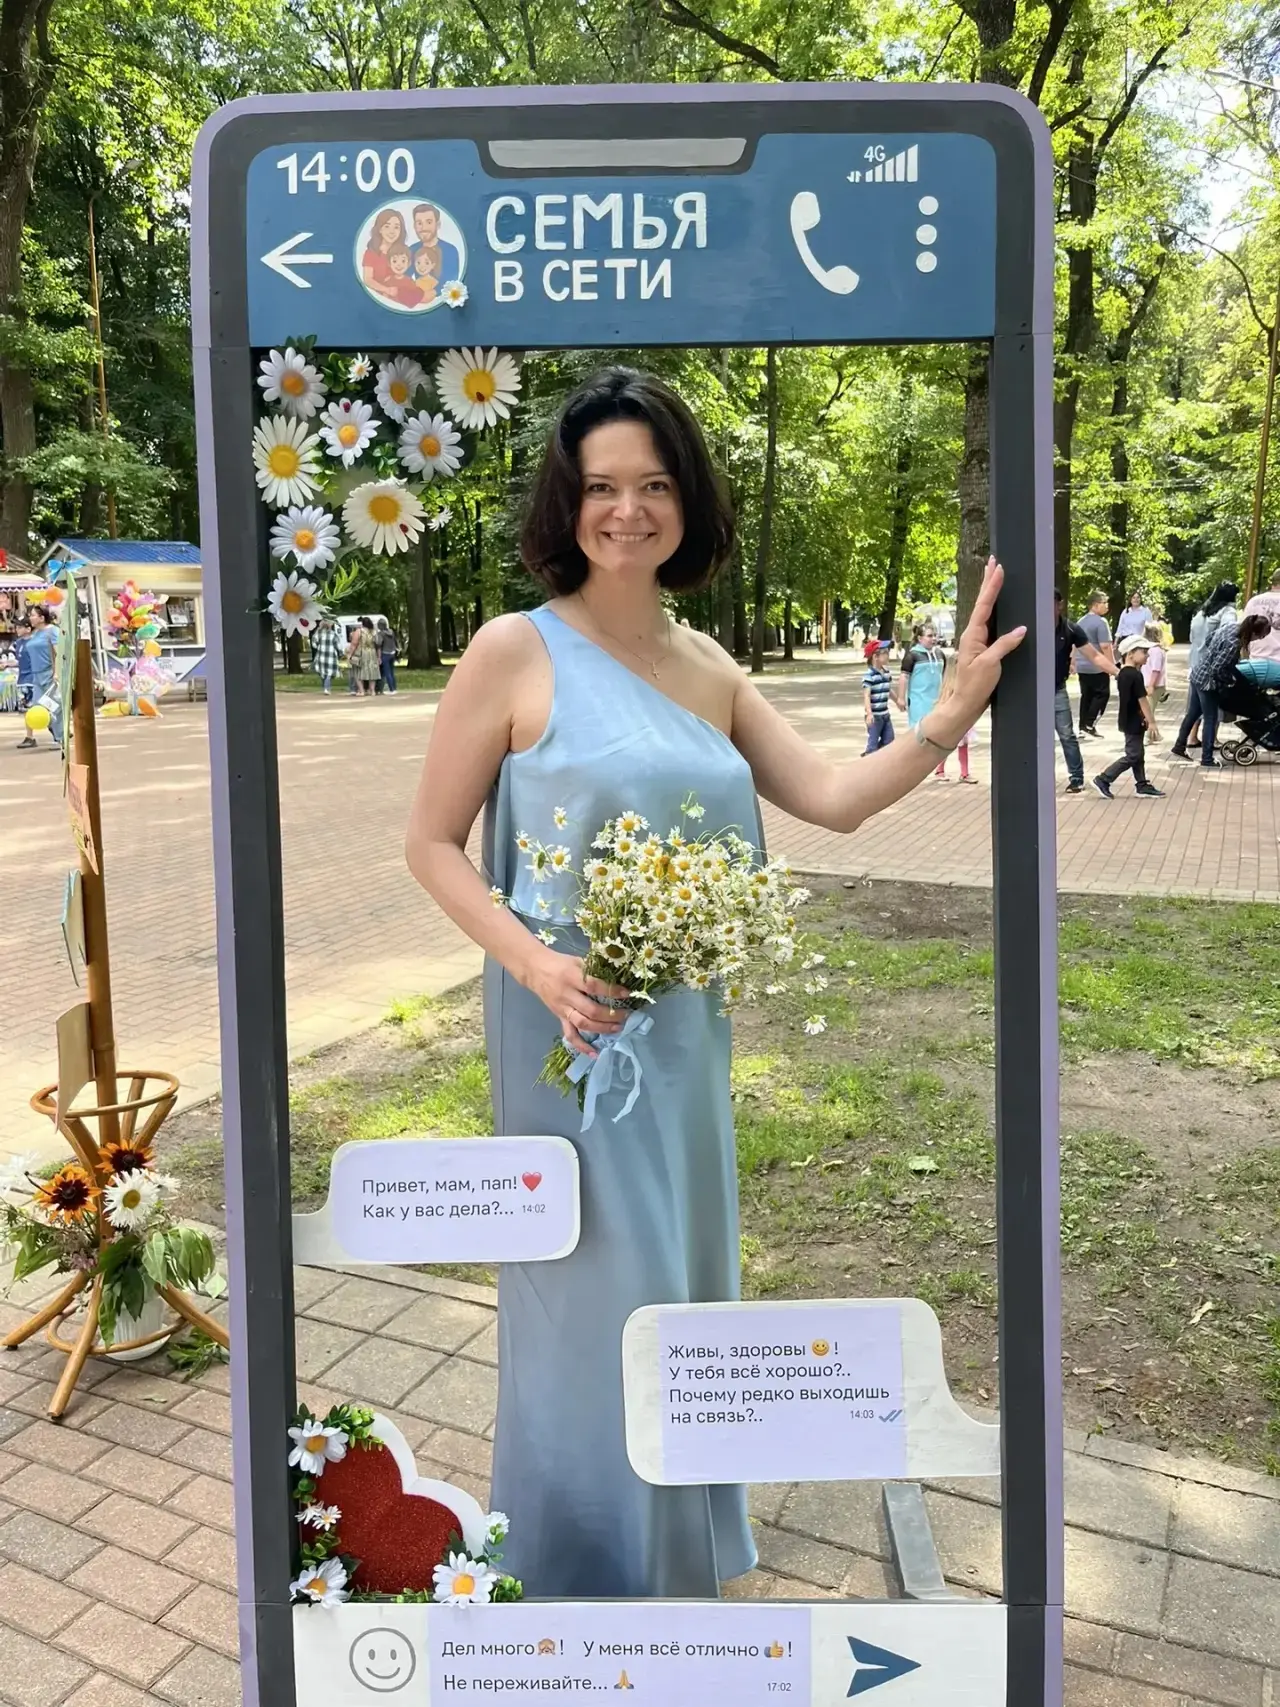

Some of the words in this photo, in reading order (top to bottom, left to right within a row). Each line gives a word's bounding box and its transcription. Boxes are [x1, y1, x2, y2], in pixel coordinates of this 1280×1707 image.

[863, 144, 886, 163] 4G
[276, 147, 416, 195] 14:00
[486, 191, 708, 254] СЕМЬЯ
[494, 260, 524, 302] В
[542, 258, 672, 302] СЕТИ
[362, 1179, 430, 1197] Привет,
[435, 1179, 476, 1194] мам,
[481, 1175, 518, 1191] пап!
[363, 1203, 396, 1219] Как
[399, 1206, 410, 1222] у
[415, 1205, 445, 1218] вас
[448, 1200, 514, 1219] дела?...
[522, 1203, 546, 1214] 14:02
[667, 1344, 725, 1361] Живы,
[729, 1344, 806, 1361] здоровы
[668, 1366, 681, 1381] У
[684, 1365, 726, 1380] тебя
[730, 1363, 761, 1379] всё
[765, 1362, 851, 1382] хорошо?..
[669, 1388, 737, 1406] Почему
[741, 1388, 795, 1406] редко
[799, 1387, 890, 1402] выходишь
[671, 1411, 692, 1424] на
[696, 1407, 763, 1424] связь?..
[850, 1409, 875, 1419] 14:03
[441, 1641, 476, 1658] Дел
[583, 1640, 595, 1658] У
[598, 1643, 644, 1656] меня
[649, 1640, 681, 1656] всё
[685, 1644, 760, 1657] отлично
[443, 1674, 468, 1691] Не
[472, 1675, 608, 1693] переживайте...
[767, 1682, 792, 1692] 17:02
